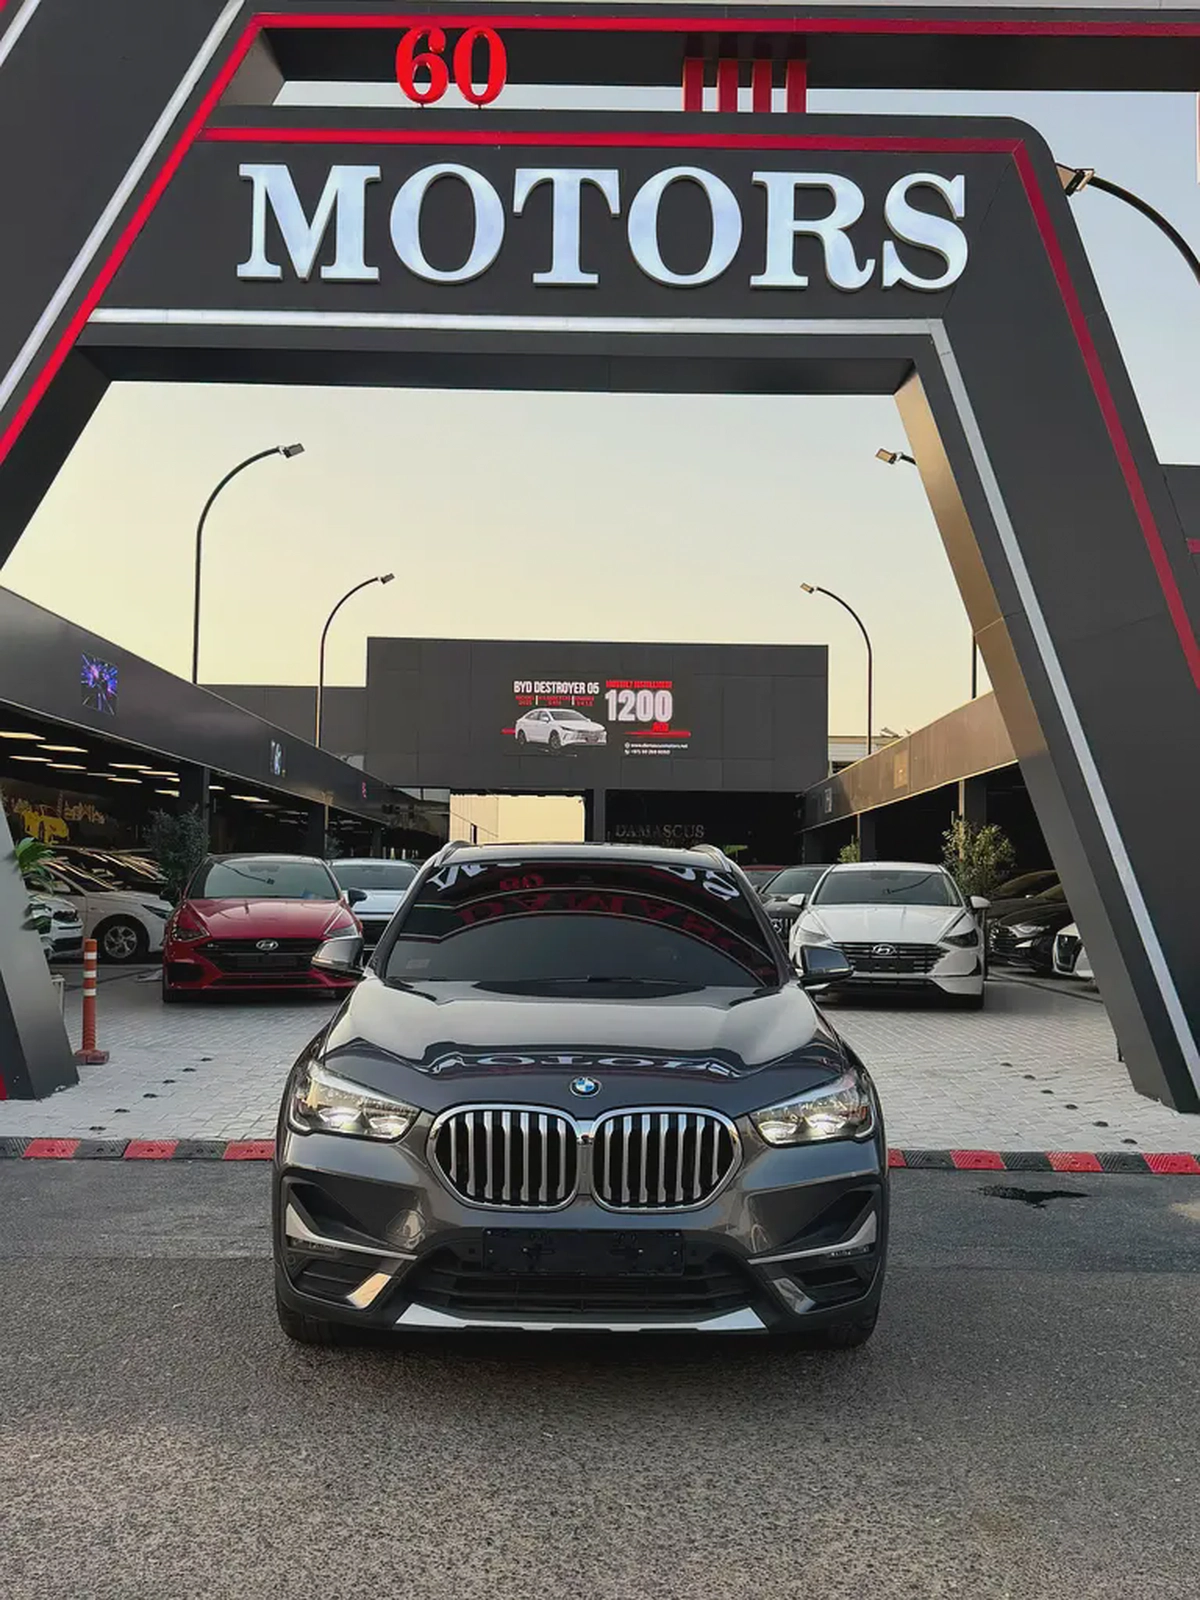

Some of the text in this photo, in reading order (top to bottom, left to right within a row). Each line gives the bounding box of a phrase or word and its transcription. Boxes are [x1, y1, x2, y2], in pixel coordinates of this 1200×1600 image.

[396, 25, 507, 105] 60
[236, 162, 969, 293] MOTORS
[513, 681, 533, 693] BYD
[534, 681, 586, 695] DESTROYER
[587, 682, 600, 695] 05
[605, 689, 674, 722] 1200
[615, 824, 705, 838] DAMASCUS
